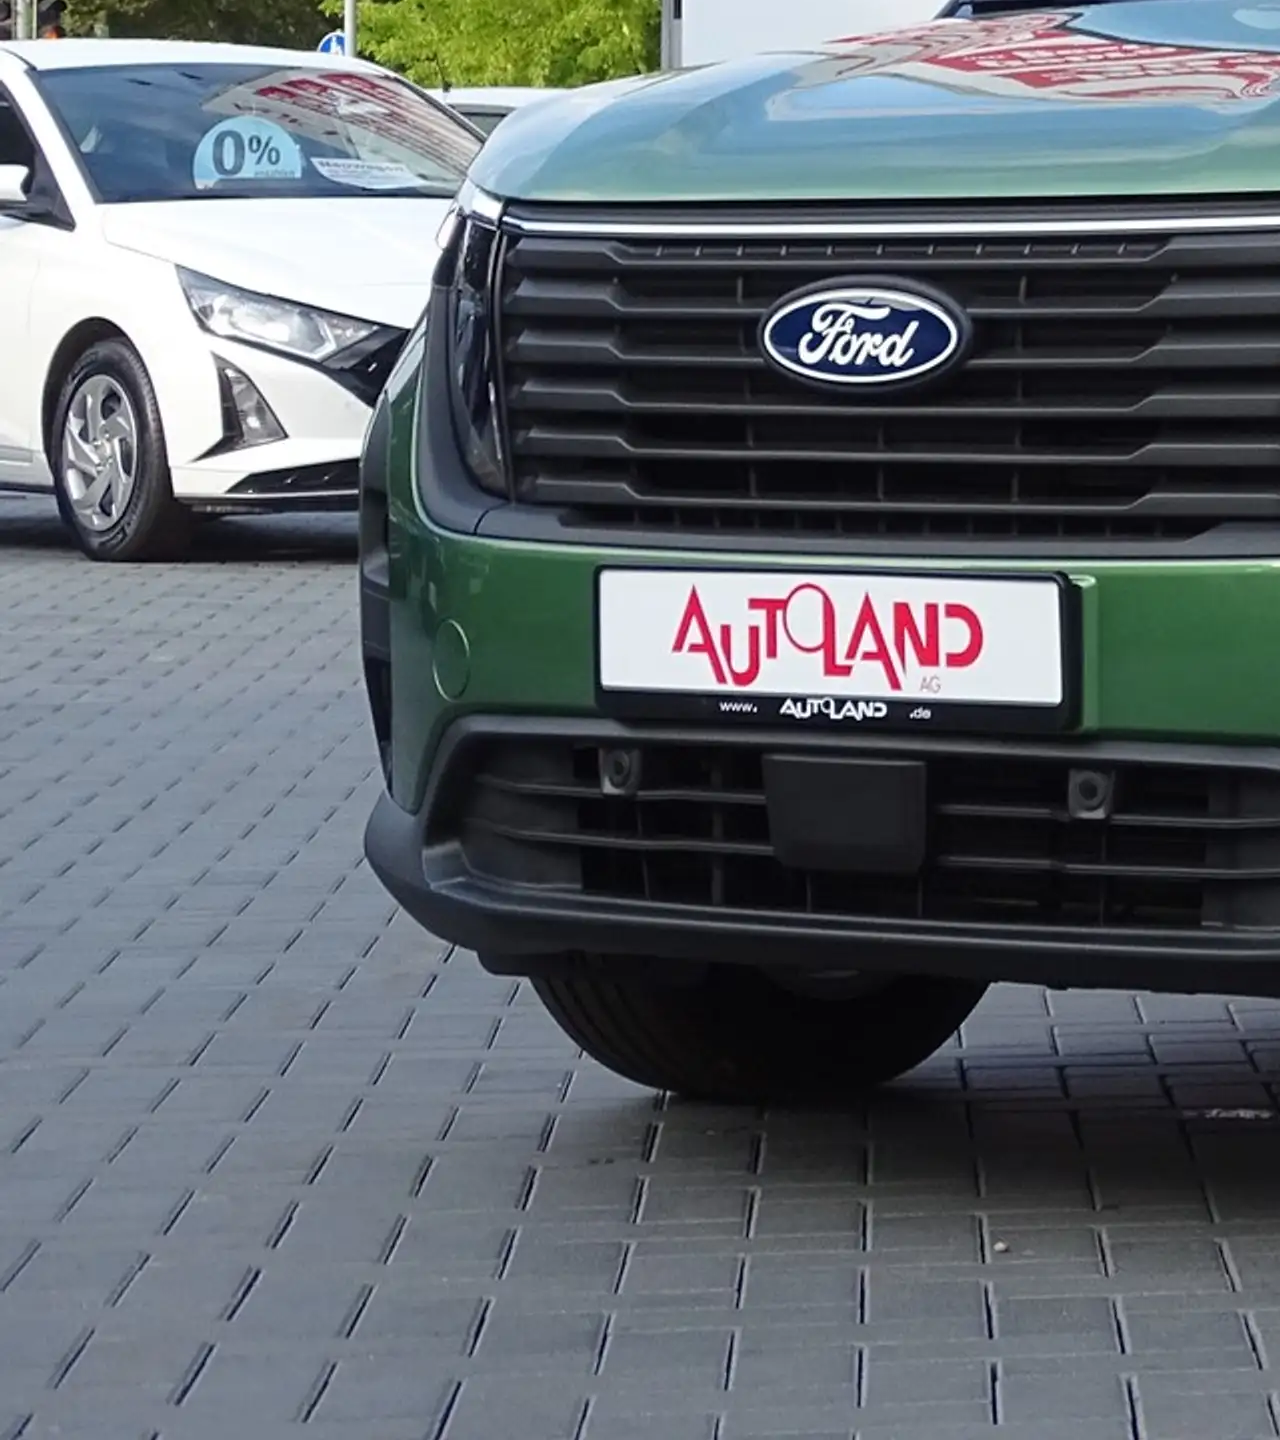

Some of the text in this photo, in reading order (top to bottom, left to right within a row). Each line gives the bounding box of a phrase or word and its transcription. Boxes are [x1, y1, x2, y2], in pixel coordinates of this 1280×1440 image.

[212, 129, 281, 176] 0%
[799, 303, 919, 367] Ford
[672, 583, 984, 691] AUTOLAND
[920, 676, 941, 693] AG
[719, 703, 758, 714] www.
